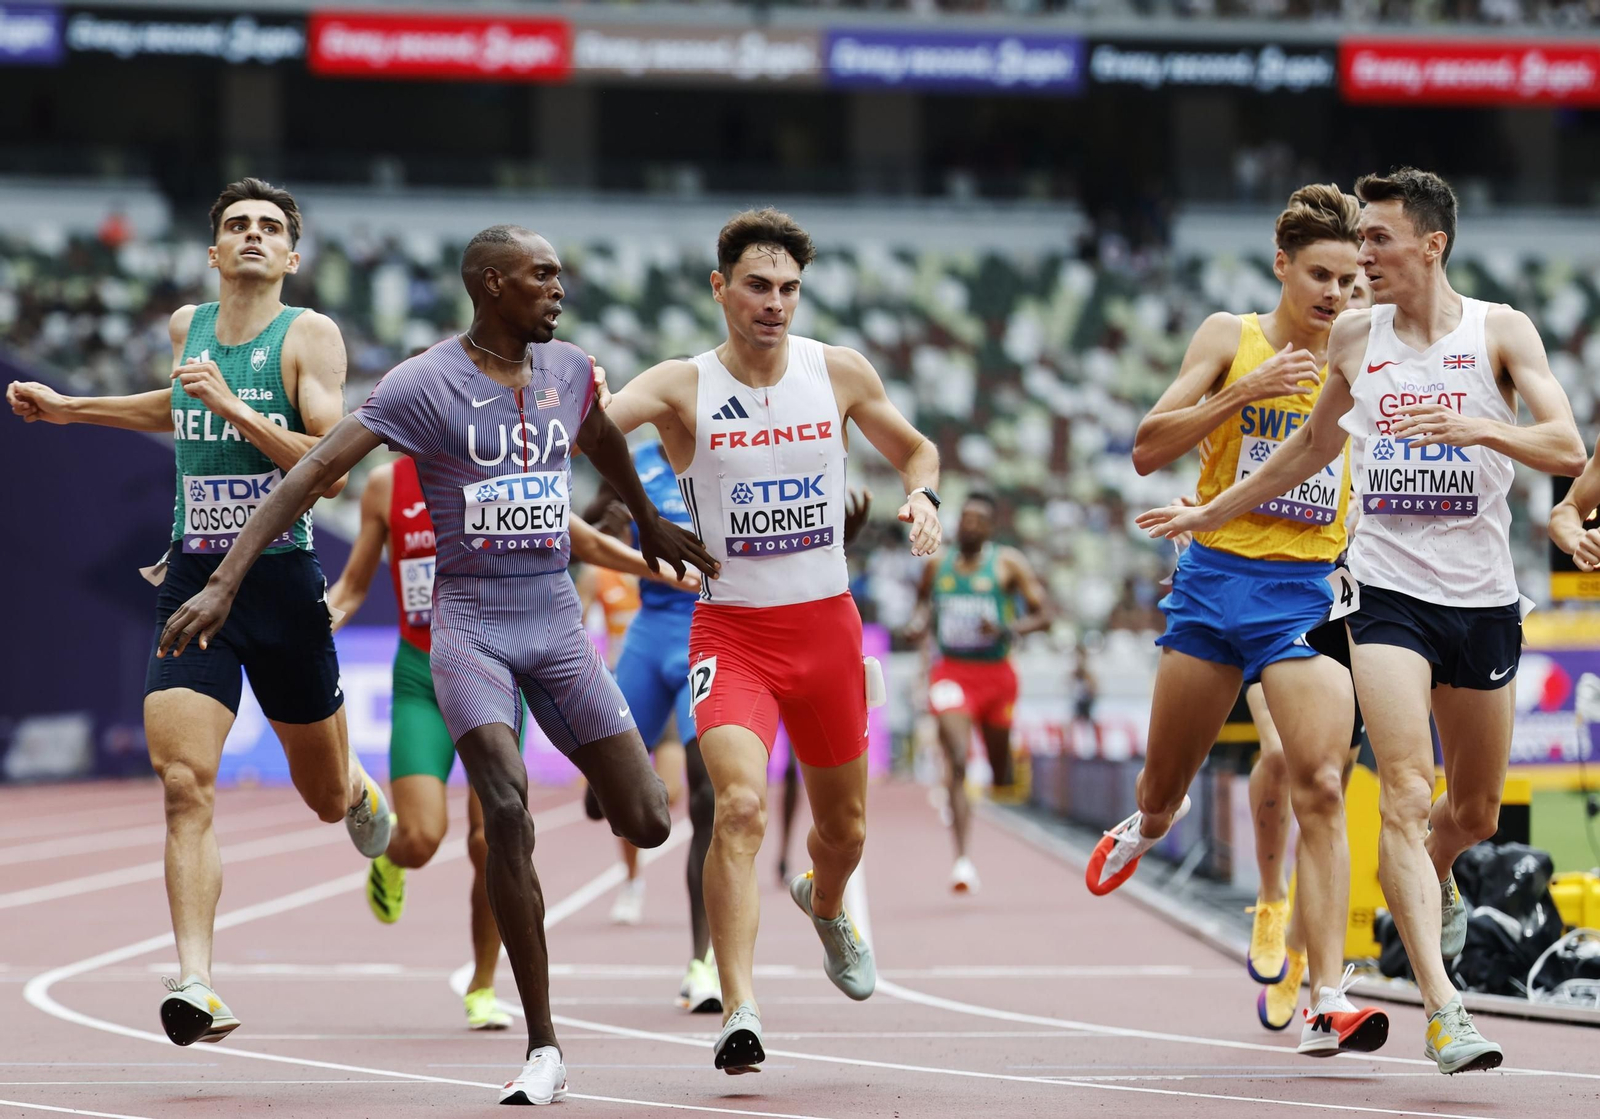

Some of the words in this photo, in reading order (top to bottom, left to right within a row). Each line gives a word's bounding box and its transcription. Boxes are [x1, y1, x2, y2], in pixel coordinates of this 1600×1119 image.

[237, 388, 273, 400] 123.ie
[1397, 382, 1445, 394] Novuna
[1240, 405, 1311, 438] SWE
[468, 419, 570, 466] USA
[710, 421, 832, 450] FRANCE
[1395, 438, 1471, 462] TDK
[204, 475, 275, 501] TDK
[496, 476, 563, 501] TDK
[753, 474, 825, 503] TDK
[1368, 469, 1474, 493] WIGHTMAN
[472, 507, 490, 530] J.
[497, 505, 565, 530] KOECH
[730, 502, 828, 535] MORNET
[1340, 575, 1354, 607] 4
